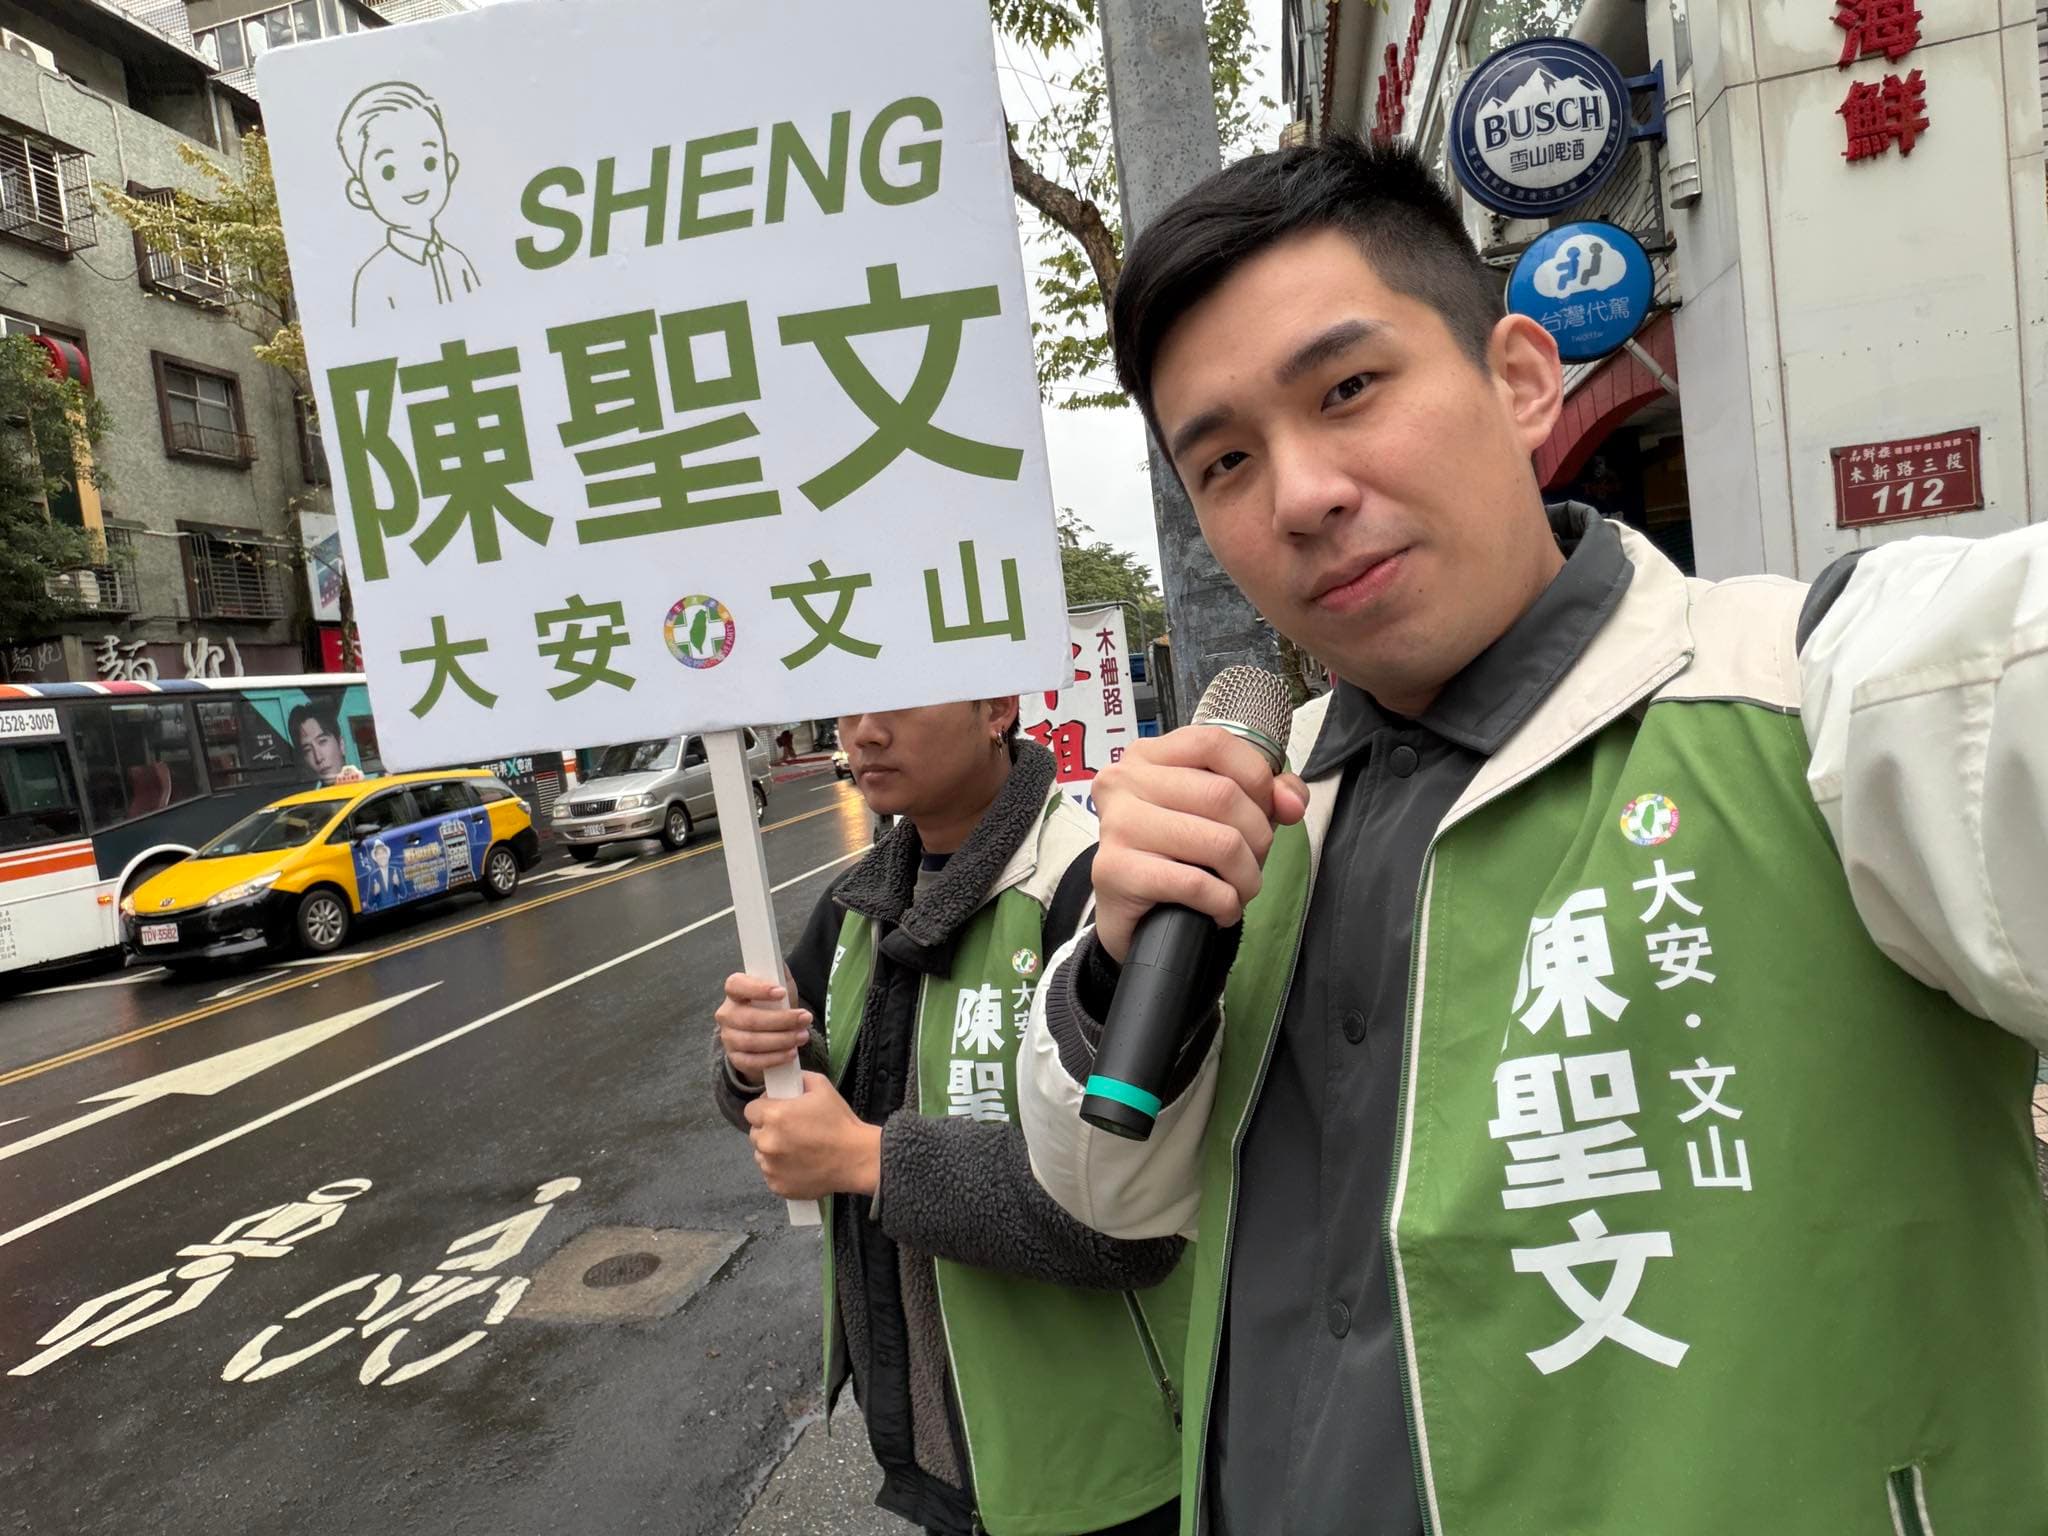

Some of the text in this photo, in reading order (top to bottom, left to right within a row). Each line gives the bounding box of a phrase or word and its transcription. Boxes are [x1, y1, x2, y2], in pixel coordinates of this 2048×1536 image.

[1483, 96, 1604, 151] BUSCH
[1510, 139, 1584, 173] 雪山啤酒
[514, 95, 943, 270] SHENG
[1540, 296, 1630, 333] 台灣代駕
[326, 263, 1024, 581] 陳聖文
[1850, 453, 1965, 484] 木新路三段
[1872, 479, 1945, 514] 112
[401, 539, 1026, 719] 大安 文山
